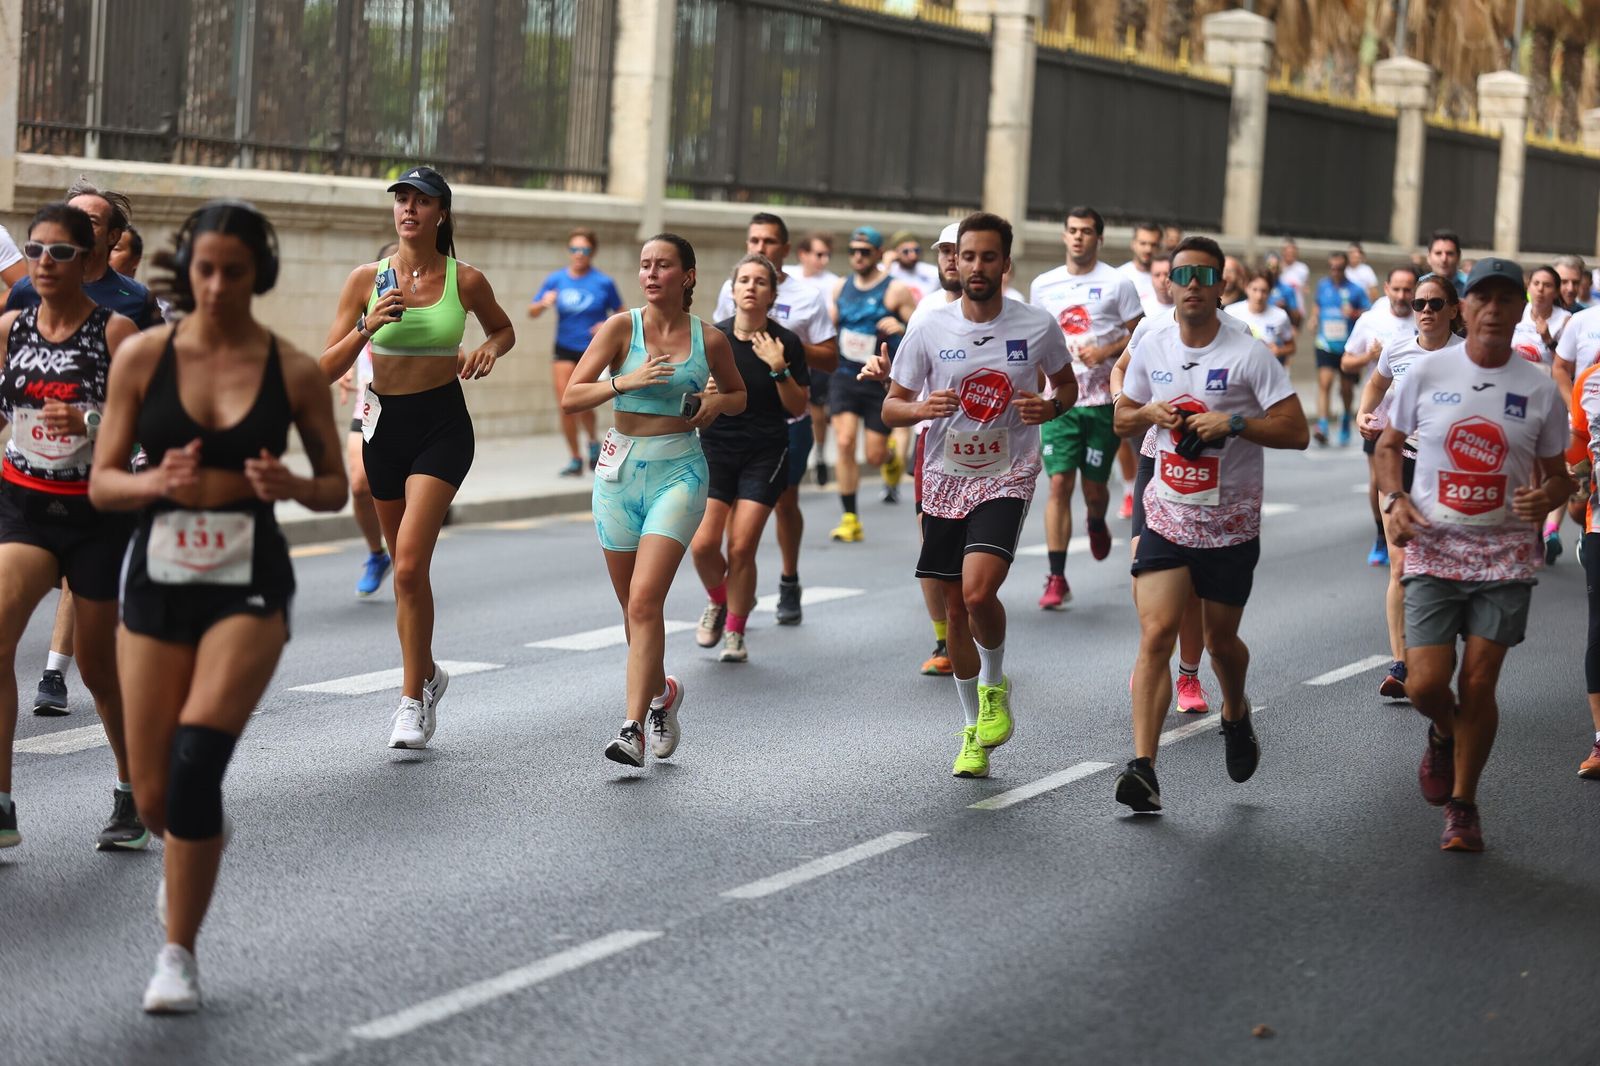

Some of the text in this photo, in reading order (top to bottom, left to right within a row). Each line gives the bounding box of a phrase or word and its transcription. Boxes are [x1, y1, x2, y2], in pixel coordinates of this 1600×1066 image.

[1007, 350, 1025, 360] AXA
[968, 382, 1007, 400] PONLE
[1206, 379, 1225, 389] AXA
[965, 392, 1003, 409] FRENO
[953, 440, 1001, 455] 1314
[1456, 429, 1501, 454] PONLE
[1085, 446, 1104, 467] 15
[1452, 441, 1497, 465] FRENO
[1164, 463, 1210, 481] 2025
[1445, 483, 1498, 500] 2026
[176, 528, 224, 549] 131
